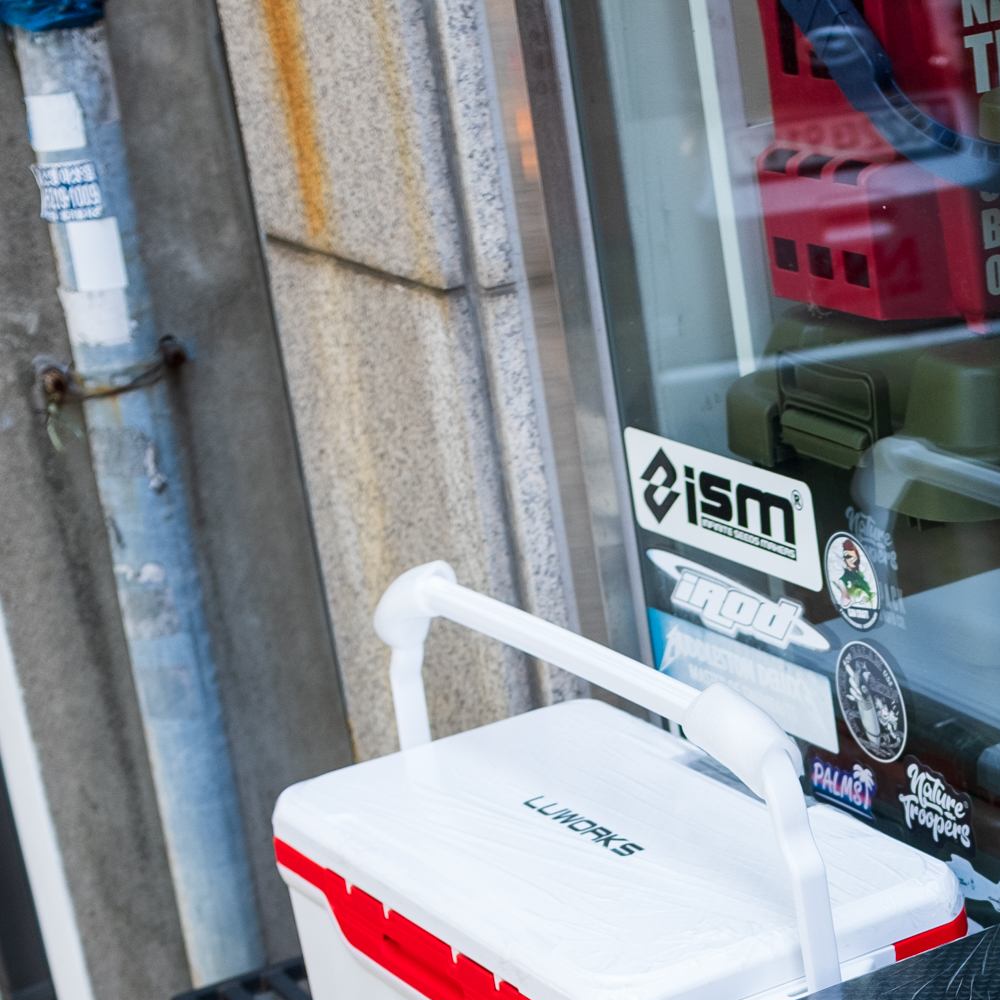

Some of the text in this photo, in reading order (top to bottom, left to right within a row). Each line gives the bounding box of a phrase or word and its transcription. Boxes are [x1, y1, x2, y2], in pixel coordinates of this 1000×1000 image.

[684, 465, 796, 545] ism
[899, 793, 970, 848] Troopers
[907, 763, 965, 819] Nature
[523, 795, 644, 857] LUWORKS
